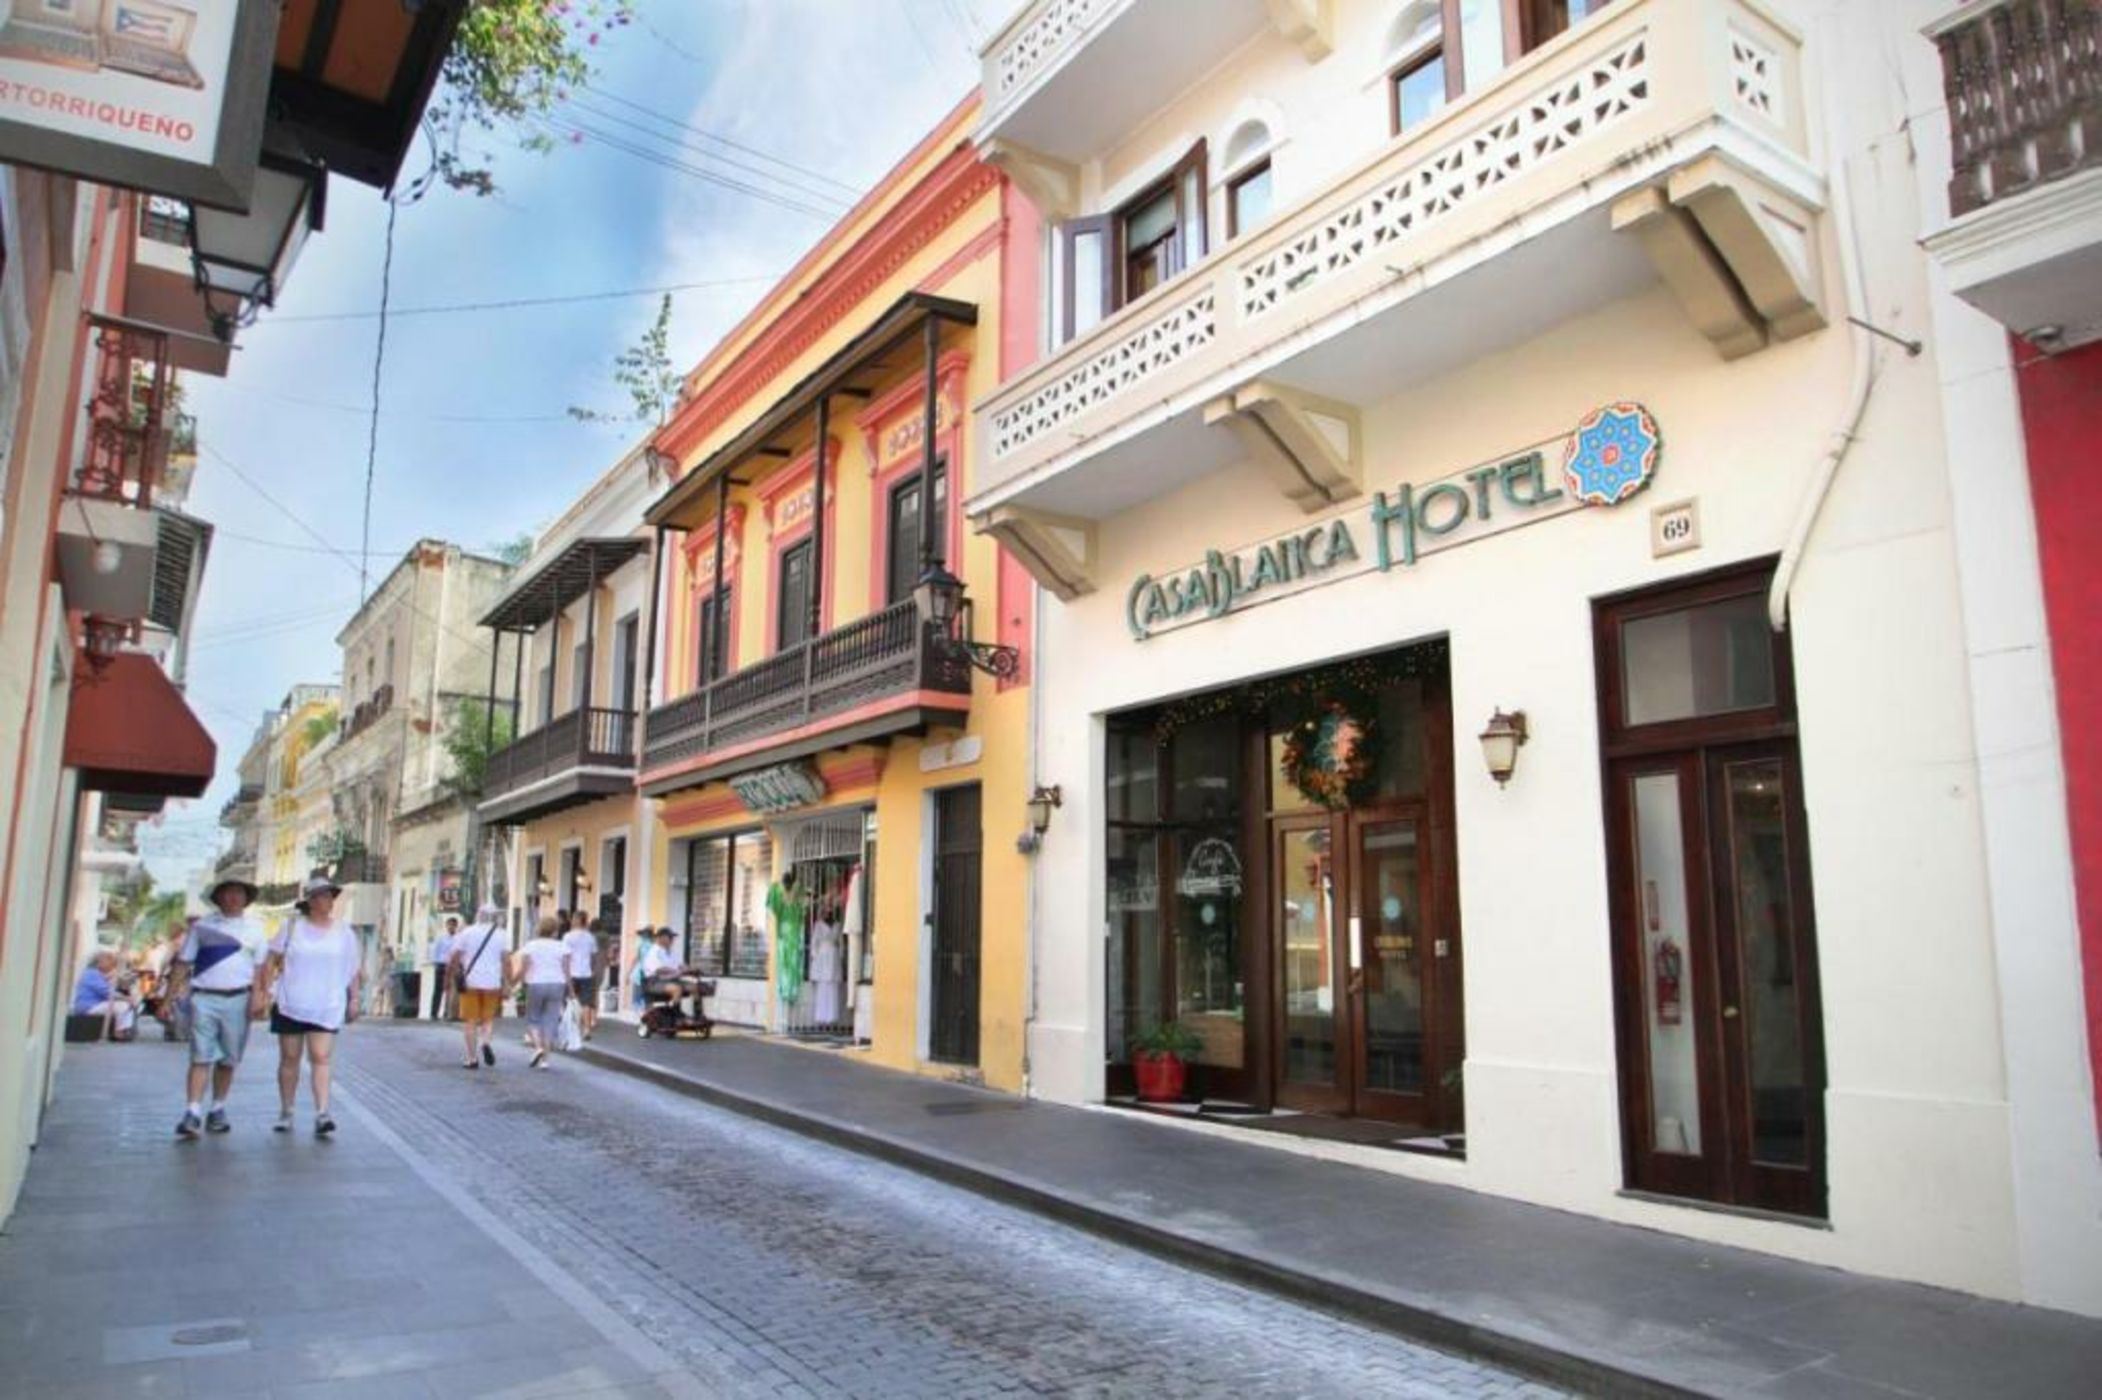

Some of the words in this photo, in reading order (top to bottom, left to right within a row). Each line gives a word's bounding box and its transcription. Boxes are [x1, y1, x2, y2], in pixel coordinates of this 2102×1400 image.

[1126, 519, 1359, 642] CASABLANCA
[1372, 452, 1563, 572] HOTEL
[1663, 517, 1690, 541] 69
